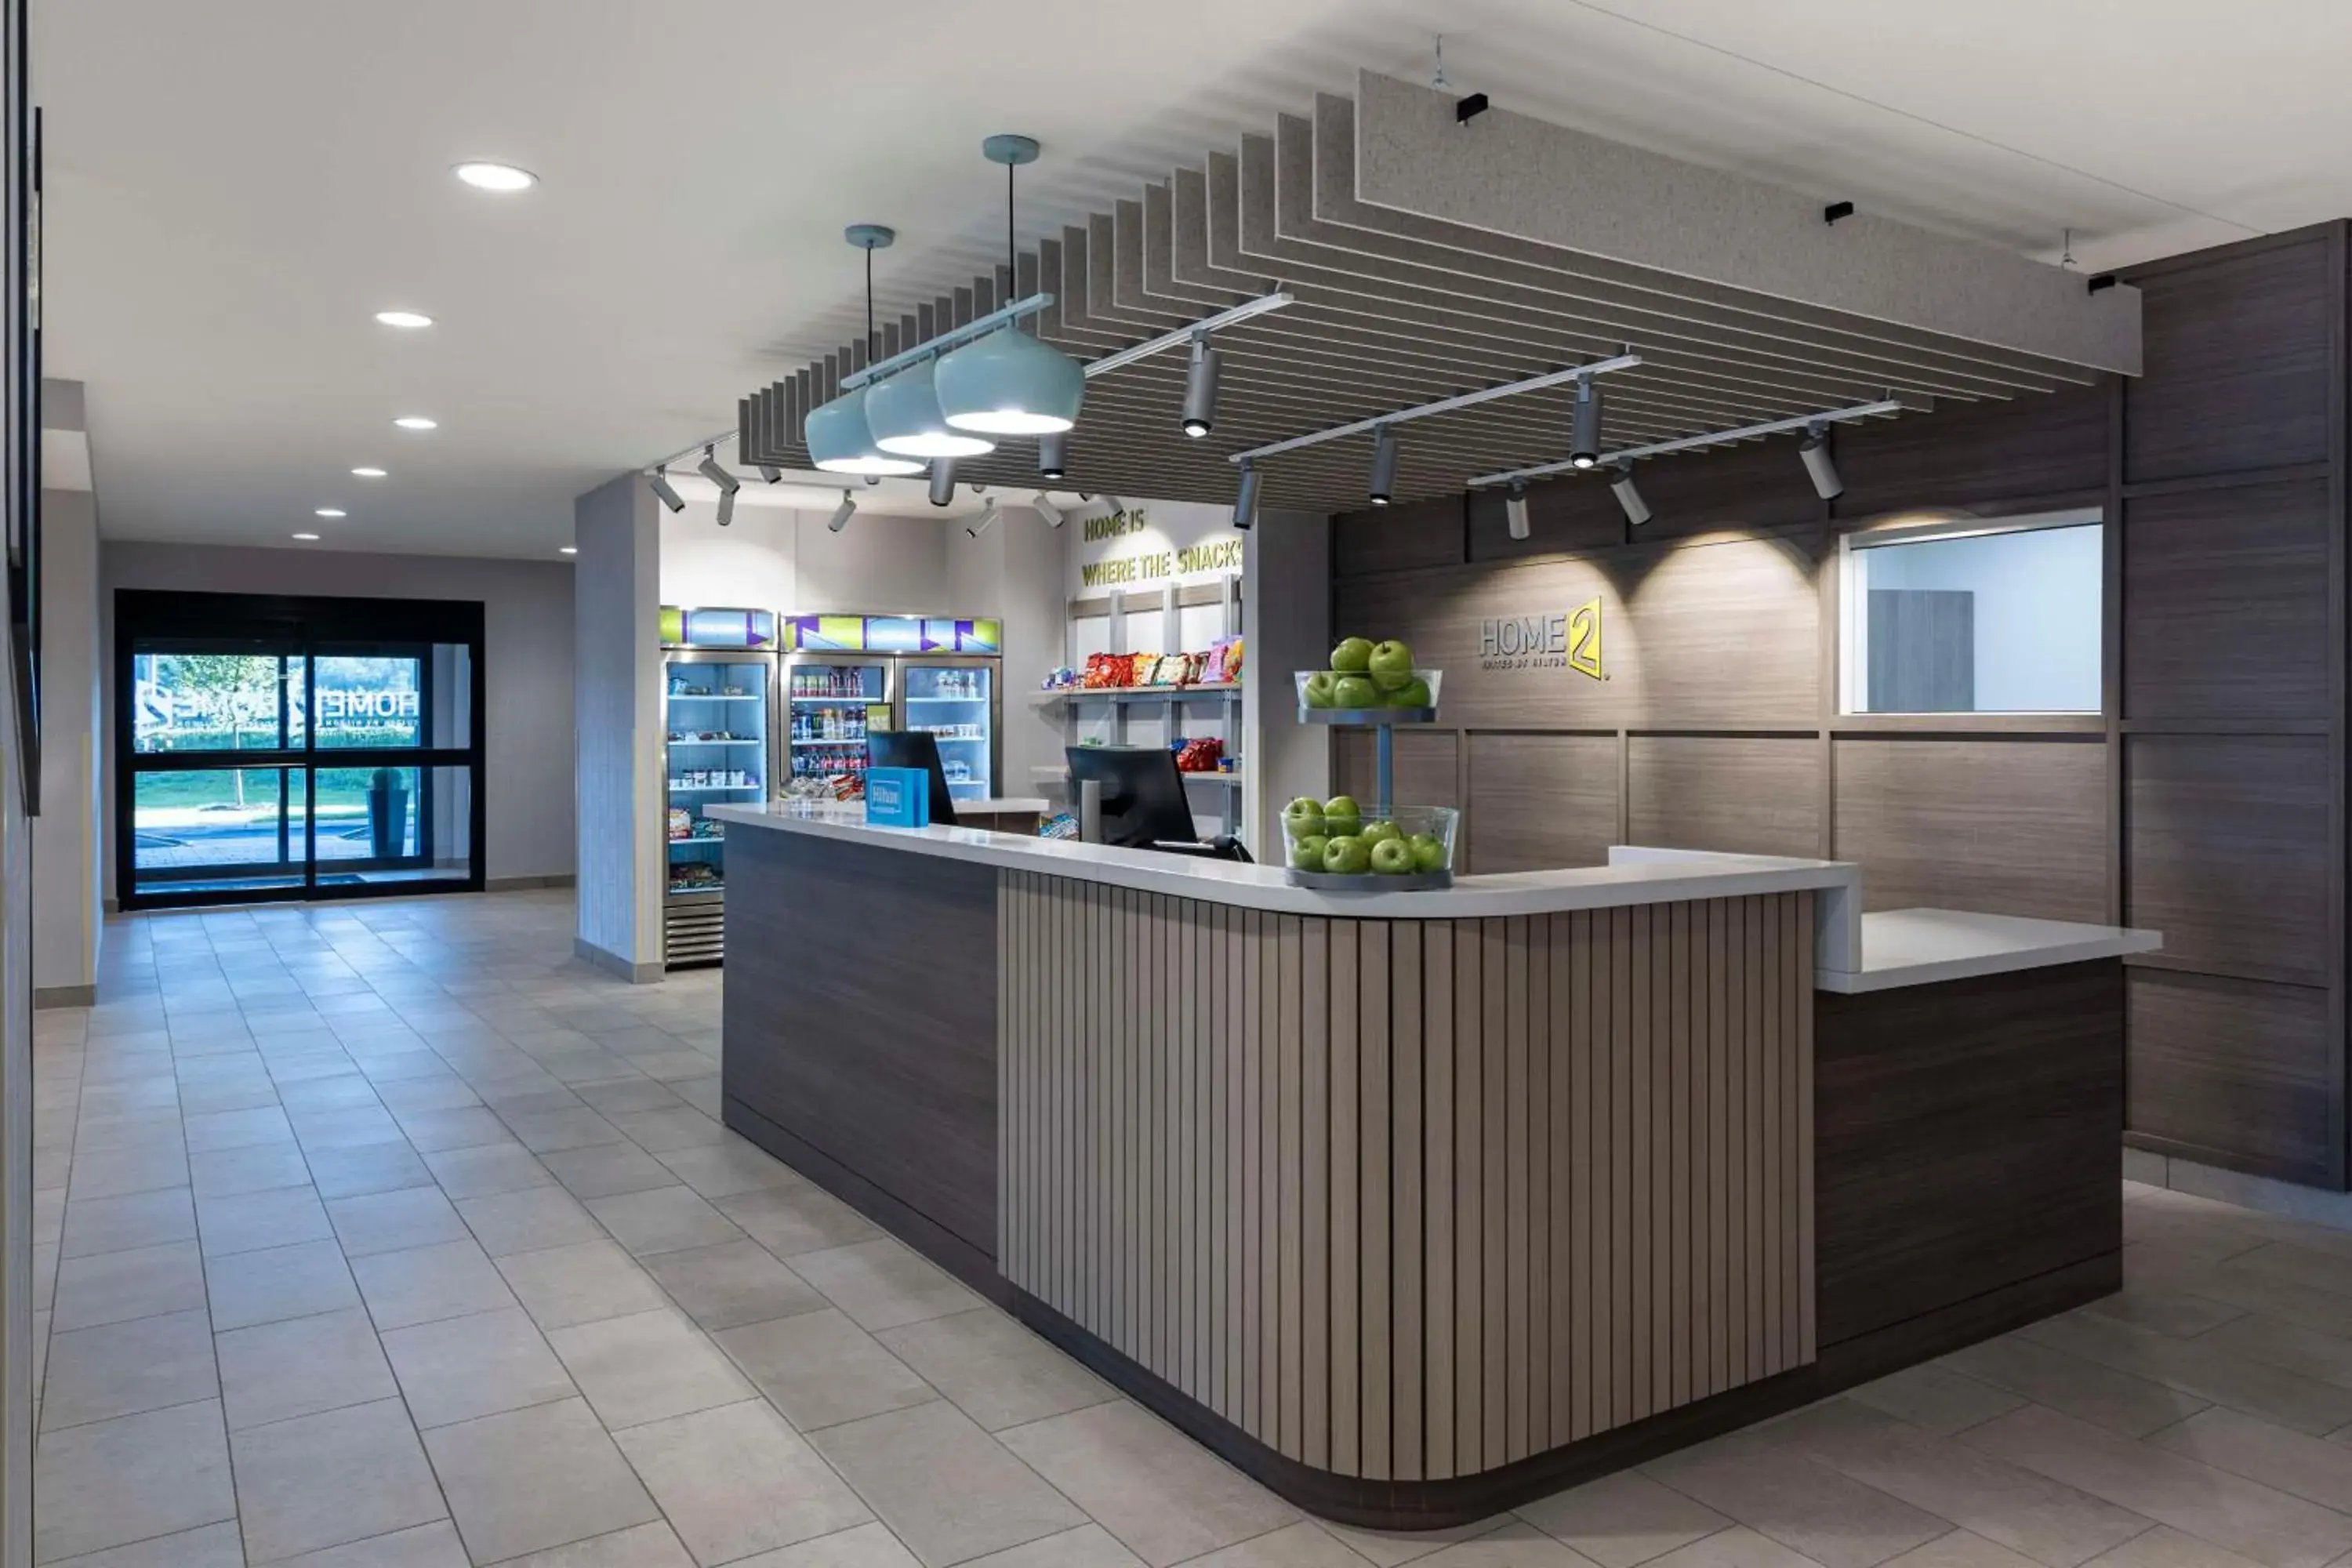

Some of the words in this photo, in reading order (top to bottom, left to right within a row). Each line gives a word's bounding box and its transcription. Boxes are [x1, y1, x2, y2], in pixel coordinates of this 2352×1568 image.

[1084, 511, 1127, 542] HOME
[1131, 508, 1145, 532] IS
[1082, 557, 1137, 586] WHERE
[1139, 551, 1171, 579] THE
[1479, 614, 1566, 658] HOME
